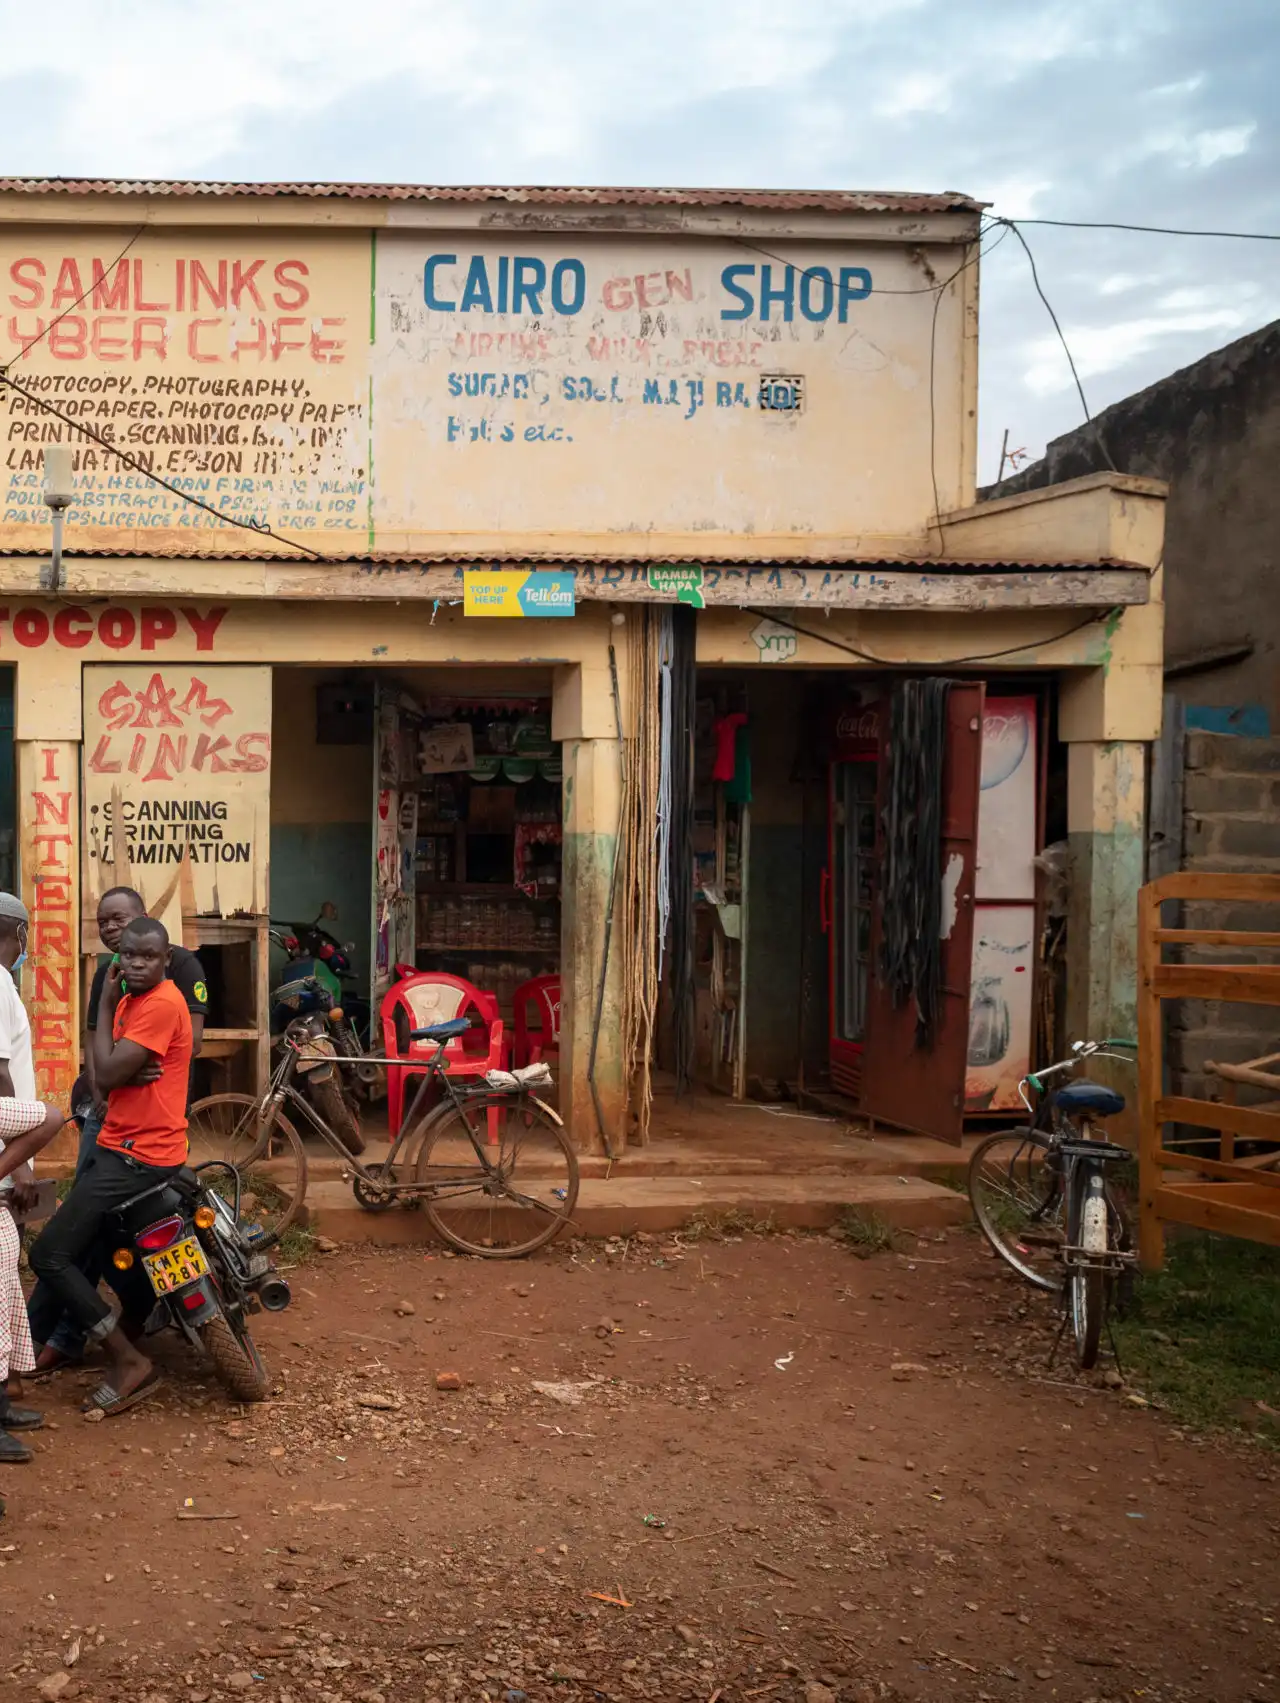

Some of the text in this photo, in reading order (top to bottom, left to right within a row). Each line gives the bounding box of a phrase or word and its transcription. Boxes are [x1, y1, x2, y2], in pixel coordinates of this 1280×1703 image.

[8, 257, 311, 312] SAMLINKS
[423, 254, 872, 323] CAIRO GEN SHOP
[187, 317, 346, 364] CAFE
[470, 585, 508, 595] TOP UP
[654, 569, 698, 581] BAMBA
[659, 581, 693, 592] HAPA
[474, 595, 504, 605] HERE
[97, 672, 235, 731] SAM
[89, 732, 271, 783] LINKS
[102, 799, 229, 821] SCANNING
[31, 748, 73, 1096] INTERNET
